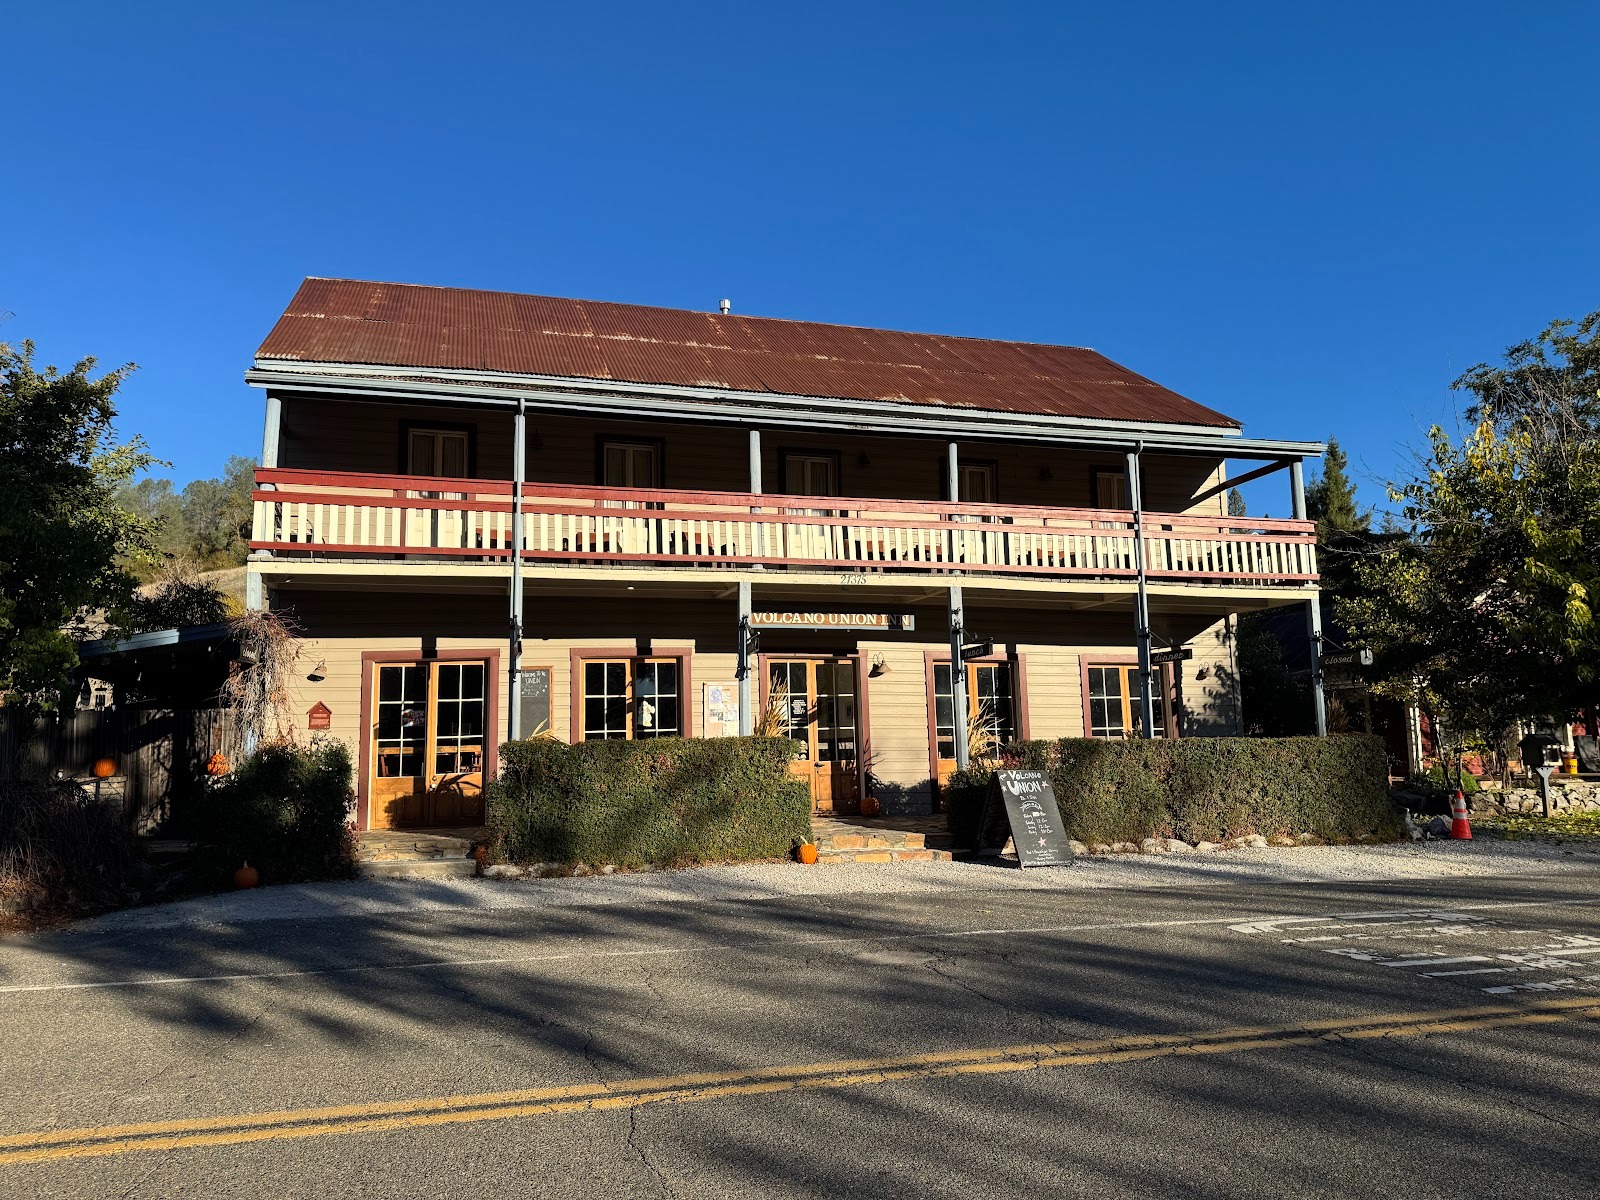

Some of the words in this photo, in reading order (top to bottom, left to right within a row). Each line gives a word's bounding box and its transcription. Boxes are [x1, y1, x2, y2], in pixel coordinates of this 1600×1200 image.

[840, 574, 867, 585] 21375
[753, 612, 825, 624] VOLCANO
[828, 613, 877, 625] UNION
[880, 614, 910, 626] INN
[1154, 652, 1185, 662] dinner
[1324, 654, 1354, 665] closed
[1008, 770, 1042, 781] VOLCANO
[1006, 780, 1042, 796] UNION
